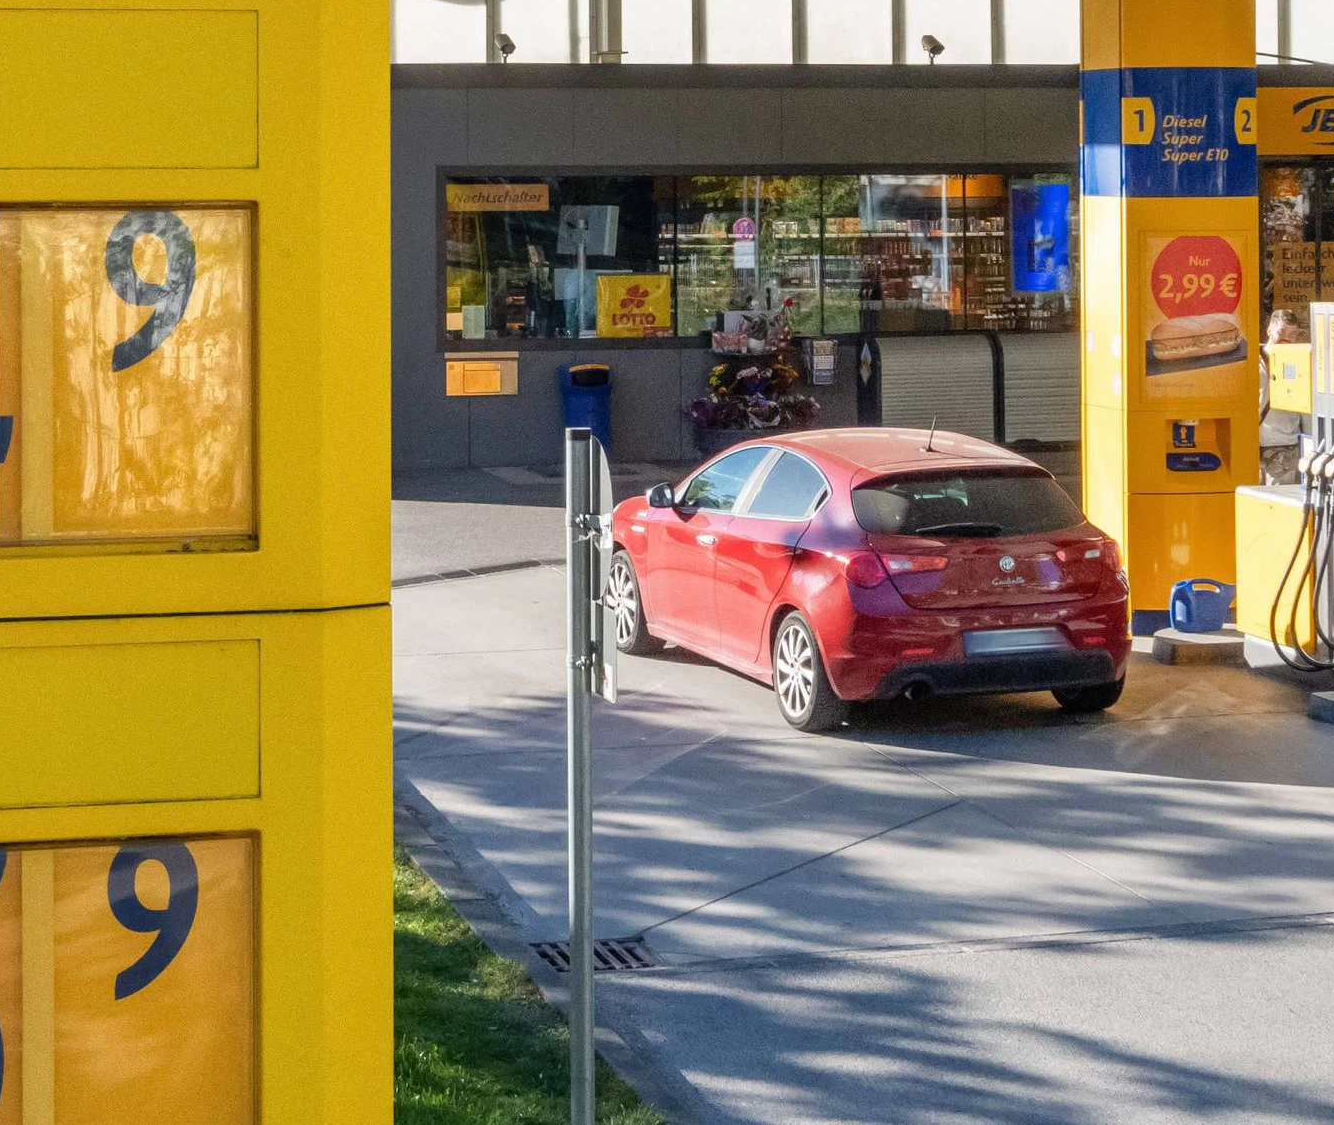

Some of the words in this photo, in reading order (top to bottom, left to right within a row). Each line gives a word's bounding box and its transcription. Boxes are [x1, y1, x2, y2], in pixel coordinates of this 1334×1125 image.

[1133, 109, 1145, 132] 1
[1162, 114, 1208, 128] Diesel
[1241, 109, 1252, 132] 2
[1161, 132, 1204, 148] Super
[1161, 149, 1204, 165] Super
[1205, 148, 1229, 162] E10
[452, 190, 545, 204] Nachtschalter
[1282, 247, 1334, 260] Einfach
[1188, 255, 1211, 267] Nur
[611, 312, 657, 326] LOTTO
